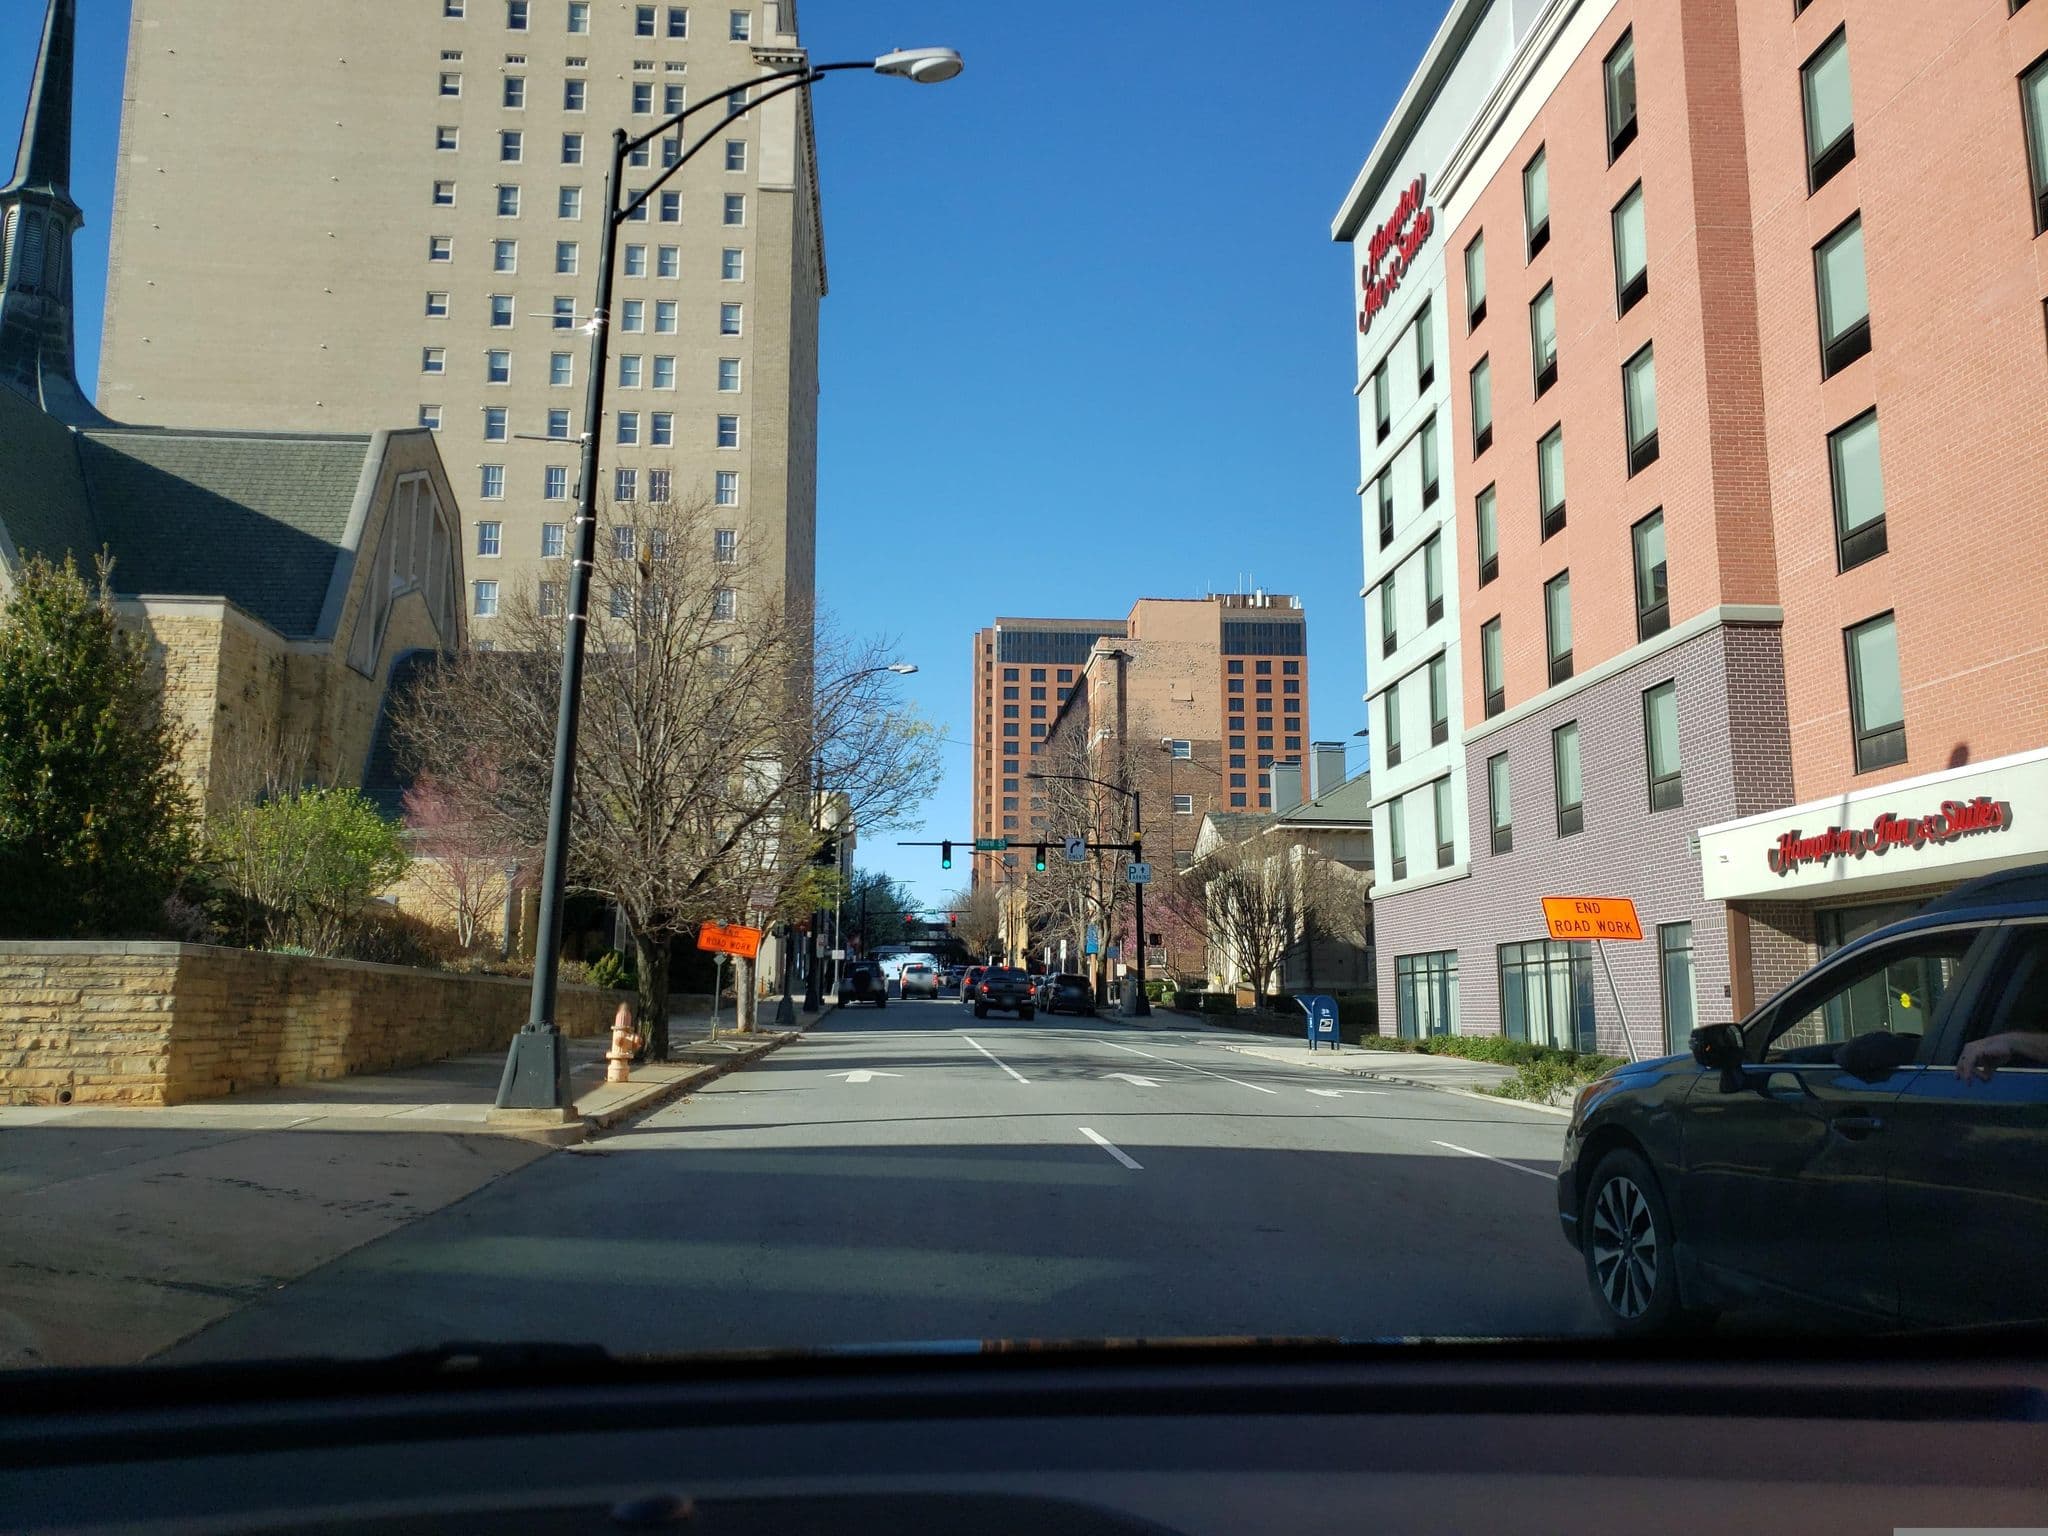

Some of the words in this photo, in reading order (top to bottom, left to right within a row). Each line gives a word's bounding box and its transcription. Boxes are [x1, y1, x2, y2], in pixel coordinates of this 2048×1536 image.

[1362, 173, 1426, 290] Hampton
[1359, 277, 1389, 335] Inn
[1396, 206, 1434, 280] Suites
[1767, 827, 1866, 876] Hampton
[1862, 813, 1918, 851] Inn
[1932, 797, 2011, 838] Suites
[1555, 920, 1591, 933] ROAD
[1596, 921, 1633, 933] WORK
[1575, 902, 1601, 914] END
[704, 935, 727, 947] ROAD
[729, 940, 753, 951] WORK
